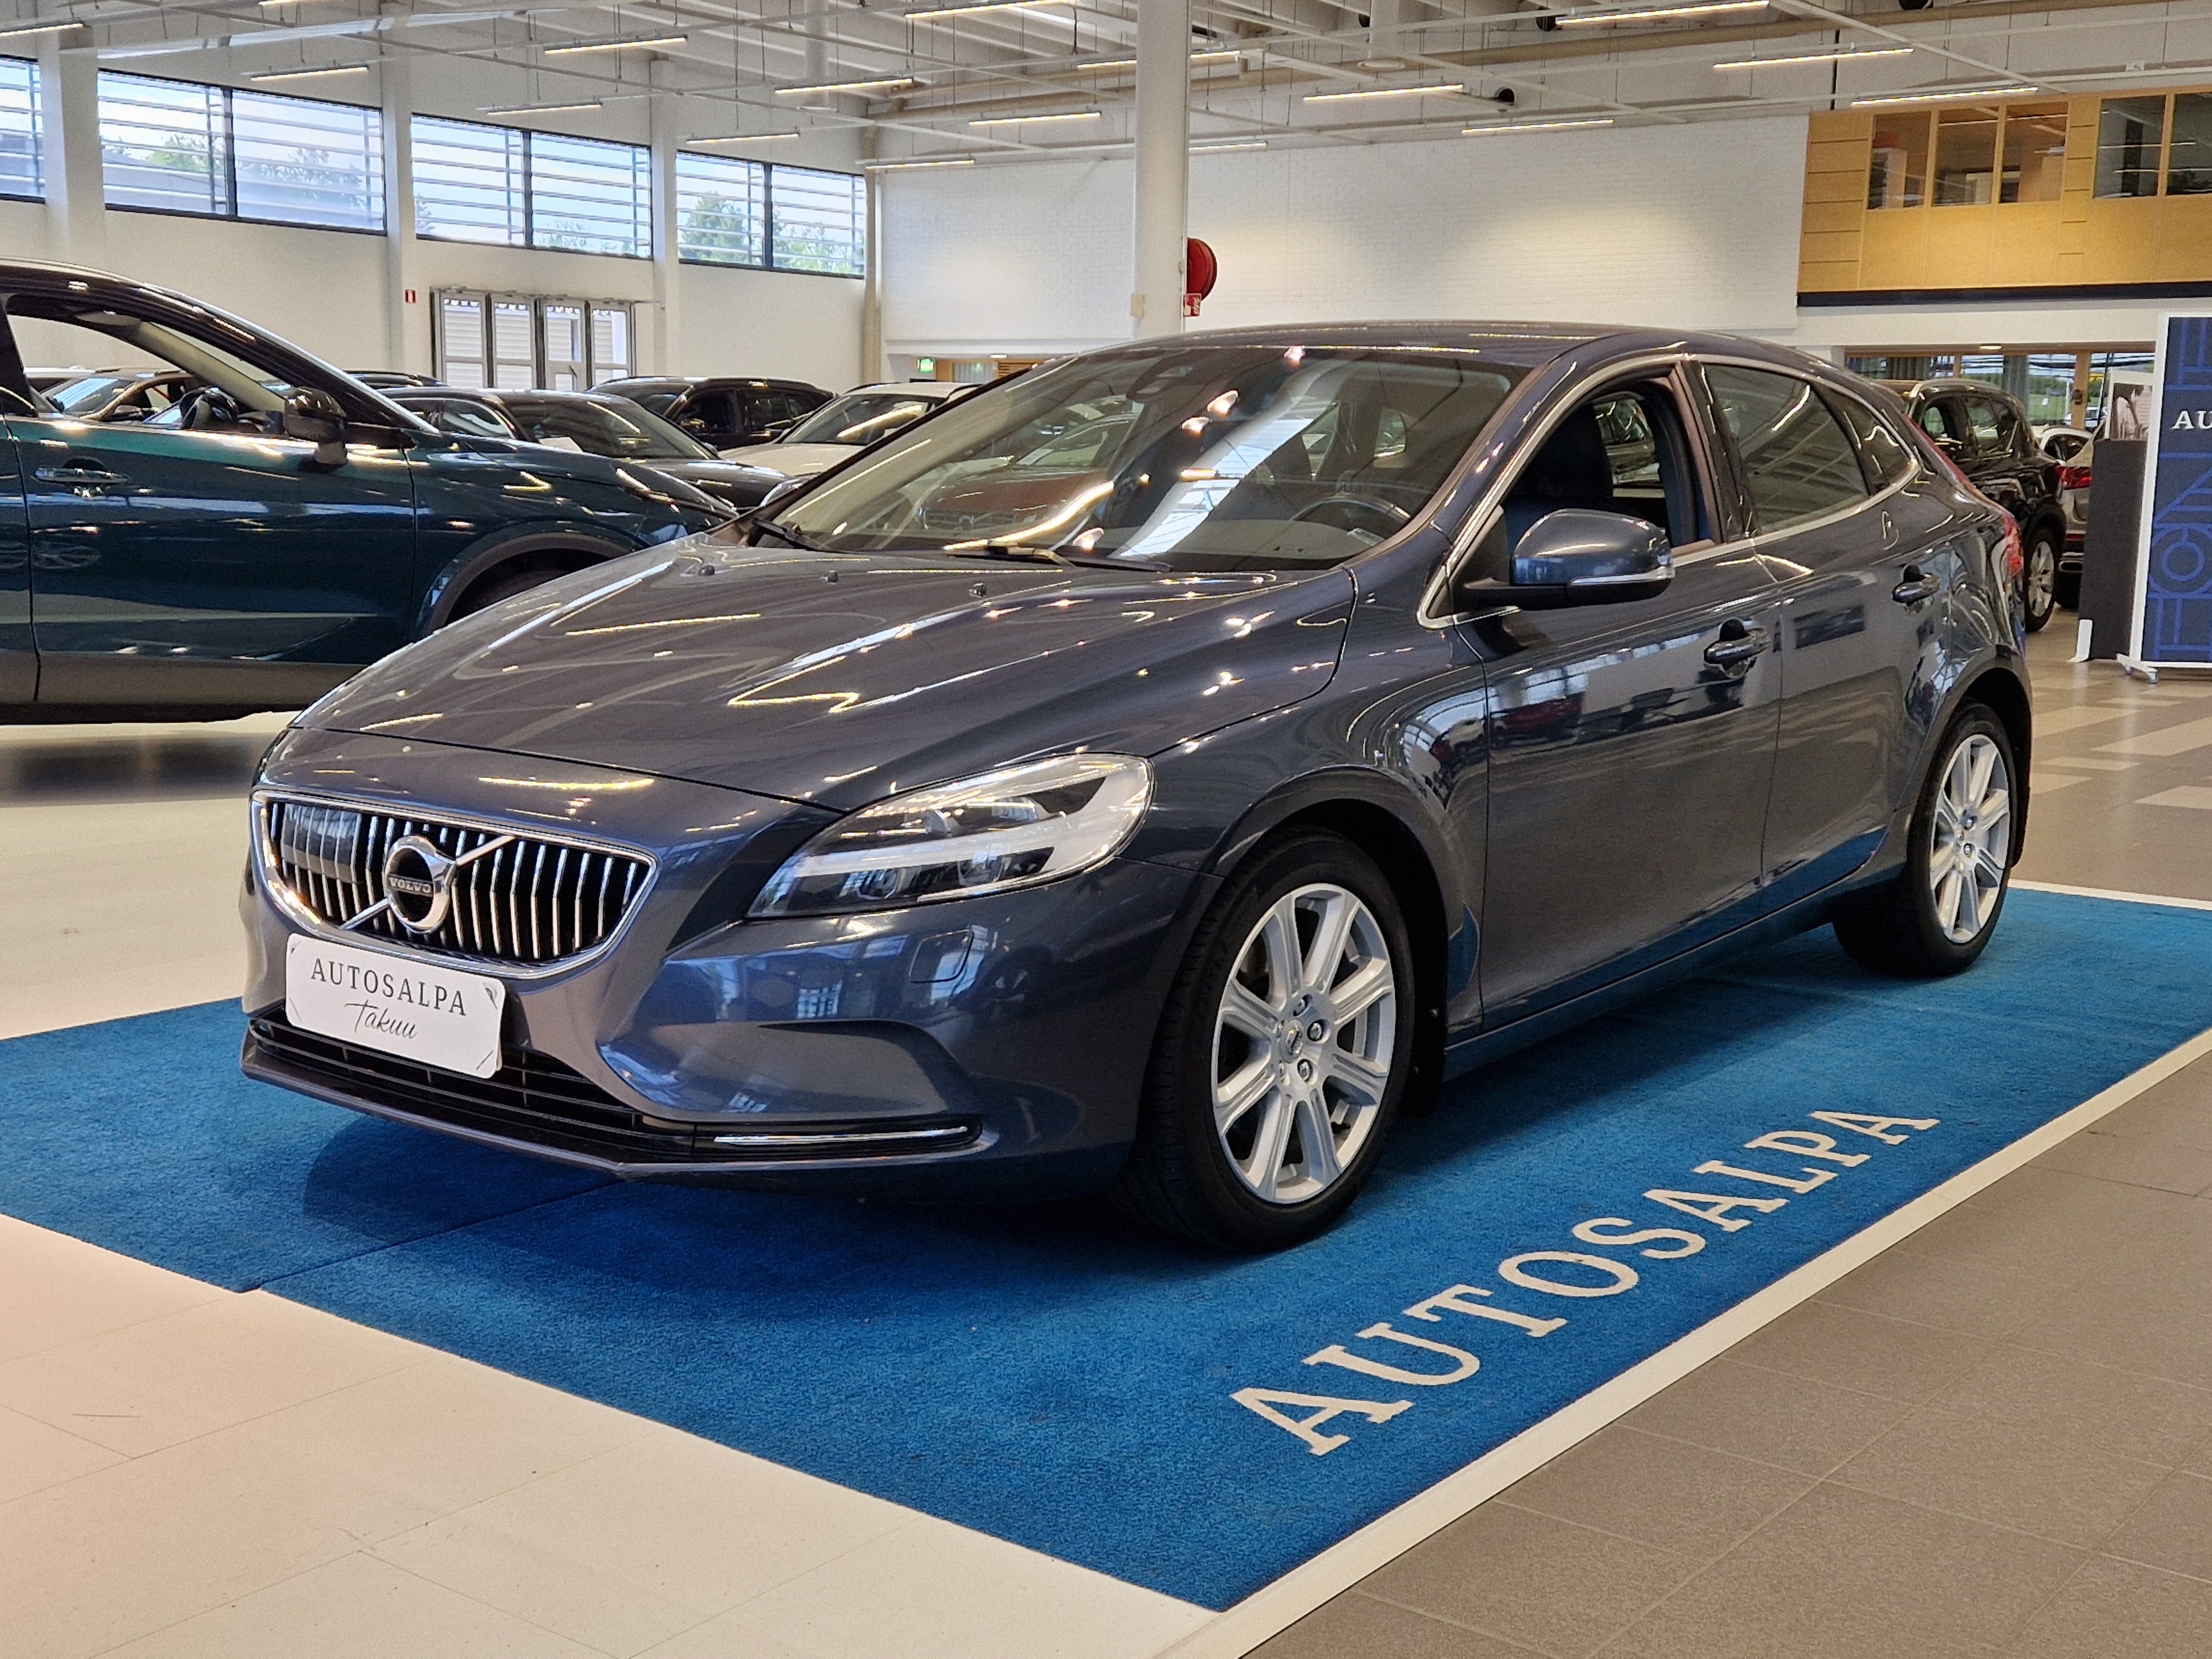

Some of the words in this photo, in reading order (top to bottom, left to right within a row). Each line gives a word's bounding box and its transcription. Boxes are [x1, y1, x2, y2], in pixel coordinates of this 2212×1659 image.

[389, 877, 431, 893] VOLVO
[311, 958, 467, 1016] AUTOSALPA
[344, 999, 417, 1039] Takuu
[1230, 1110, 1940, 1456] AUTOSALPA
